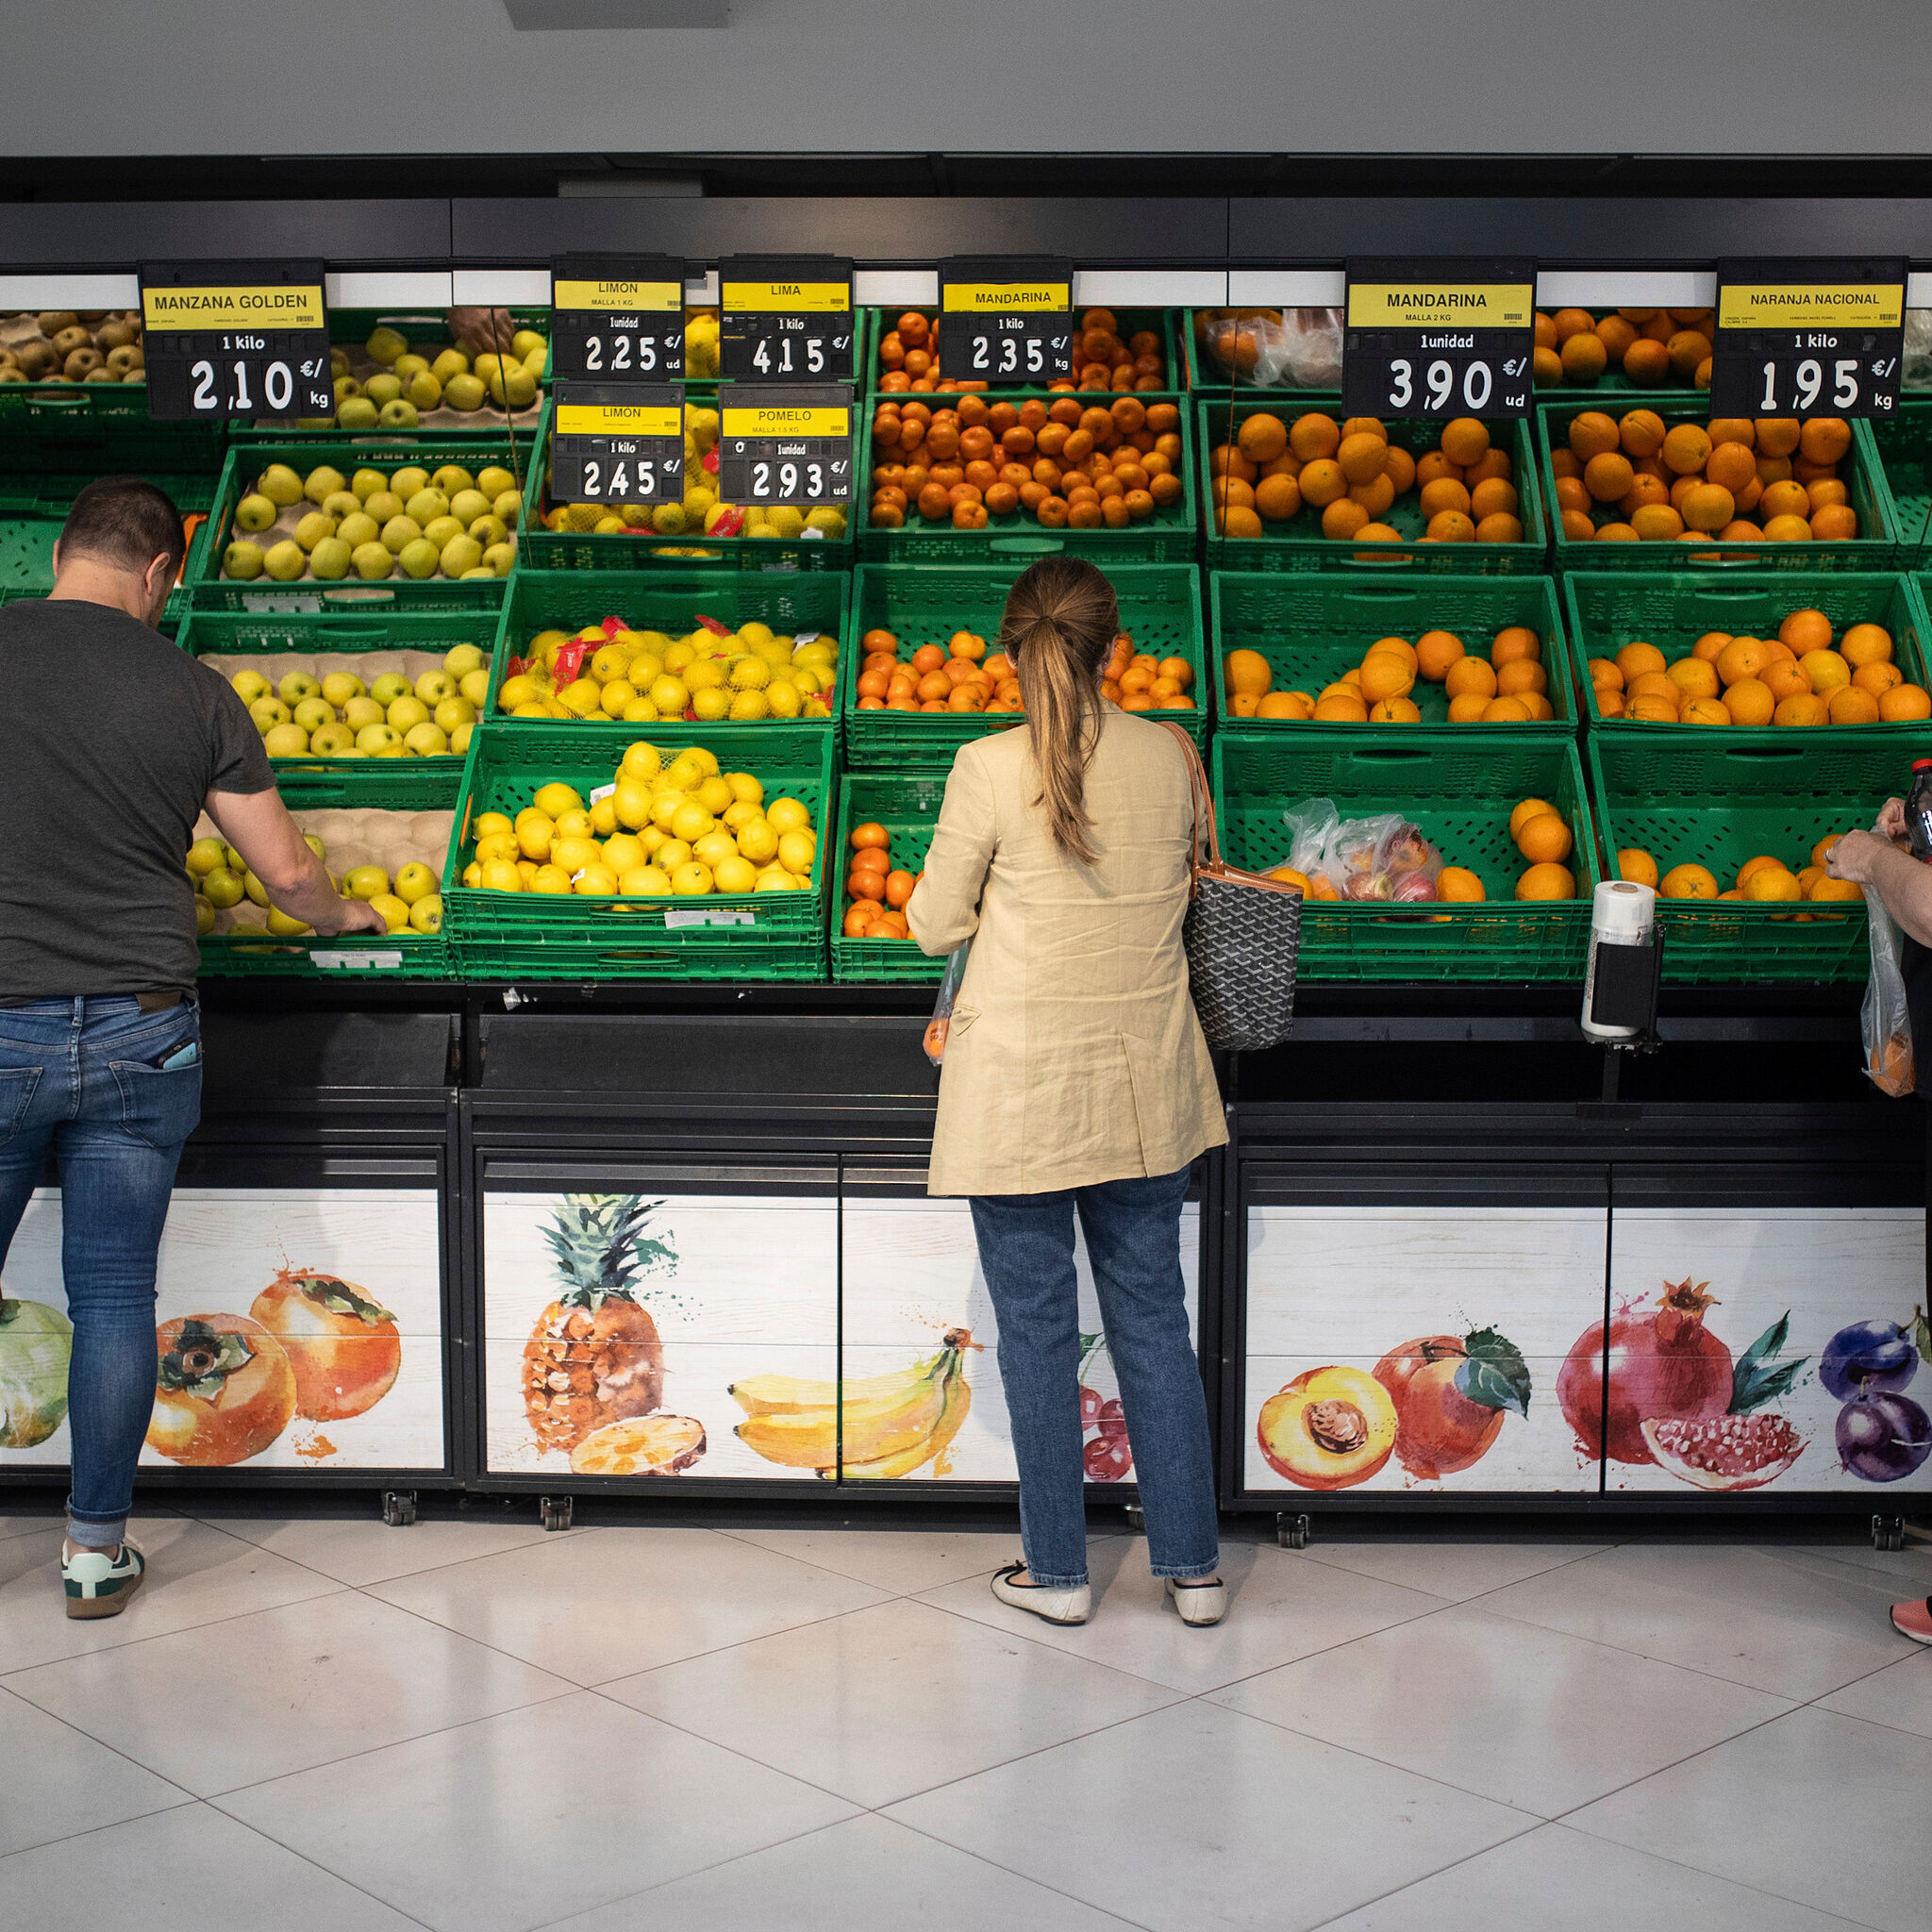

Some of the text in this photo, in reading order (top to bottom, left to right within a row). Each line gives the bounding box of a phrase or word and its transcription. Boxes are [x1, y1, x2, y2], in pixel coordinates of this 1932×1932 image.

[771, 285, 801, 295] LIMA
[154, 294, 307, 310] MANZANA GOLDEN
[975, 291, 1051, 304] MANDARINA
[1387, 293, 1488, 308] MANDARINA
[1751, 293, 1880, 305] NARANJA NACIONAL
[778, 318, 805, 330] 1 kilo
[999, 318, 1024, 329] 1 kilo
[223, 335, 266, 350] 1 kilo
[1794, 334, 1838, 348] 1 kilo
[666, 358, 681, 369] ud
[1055, 358, 1069, 370] kg
[191, 360, 293, 410] 2,10
[1389, 358, 1492, 410] 3,90
[1760, 358, 1858, 410] 1,95
[310, 391, 328, 408] kg
[1506, 393, 1525, 408] ud
[1874, 392, 1892, 409] kg
[758, 410, 811, 421] POMELO
[610, 441, 636, 454] 1 kilo
[833, 485, 848, 495] ud
